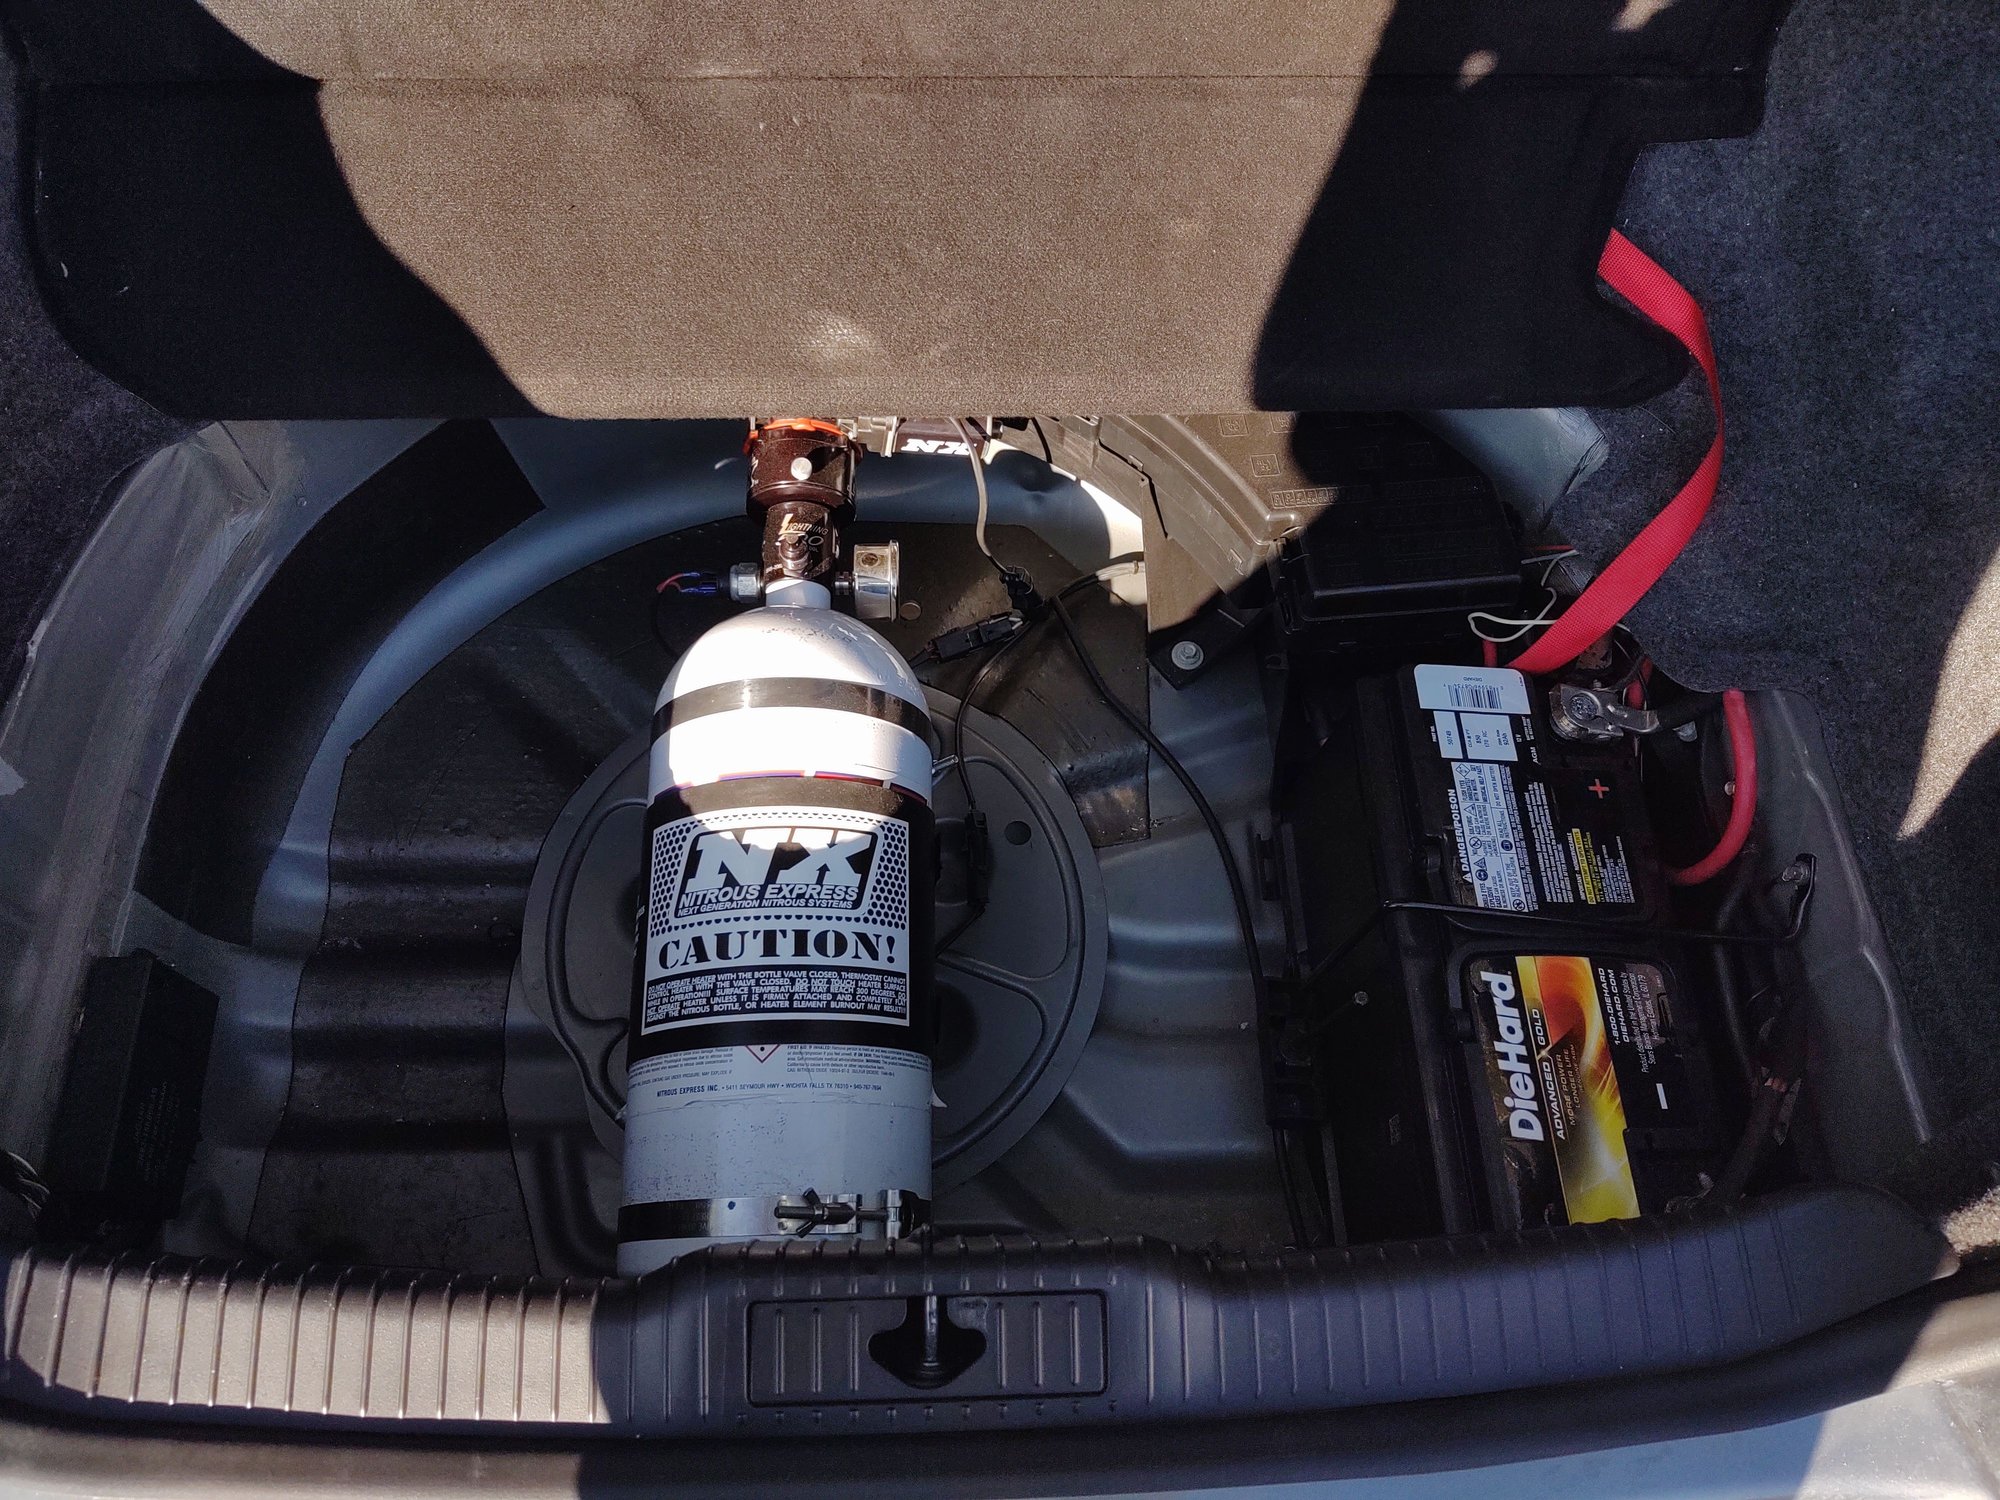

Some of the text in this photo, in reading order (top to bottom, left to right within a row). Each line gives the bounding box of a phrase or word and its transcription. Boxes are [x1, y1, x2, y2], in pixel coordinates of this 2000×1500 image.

[901, 439, 977, 455] NX
[778, 513, 829, 536] LIGHTNING
[1447, 788, 1471, 873] DANGER/POISON
[686, 827, 874, 889] NX
[1582, 865, 1590, 885] ATTEMPT
[679, 883, 859, 909] NITROUS EXPRESS
[1486, 887, 1495, 907] EXPLOSIVE
[678, 898, 853, 917] NEXT GENERATION NITROUS SYSTEMS
[658, 929, 896, 969] CAUTION!
[666, 978, 691, 990] OPERATE
[692, 975, 716, 985] HEATER
[717, 973, 737, 981] WITH
[738, 971, 753, 980] THE
[783, 970, 807, 978] VALVE
[841, 972, 882, 982] THERMOSTAT
[671, 985, 693, 994] HEATER
[695, 982, 713, 991] WITH
[733, 979, 756, 987] VALVE
[760, 978, 792, 986] CLOSED.
[795, 978, 808, 986] DO
[830, 979, 856, 988] TOUCH
[858, 981, 882, 989] HEATER
[883, 983, 906, 992] SURFACE
[1621, 979, 1629, 993] States
[1638, 975, 1648, 992] 60179
[716, 987, 748, 996] SURFACE
[751, 985, 808, 993] TEMPERATURES
[810, 985, 828, 993] MAY
[830, 985, 854, 993] REACH
[870, 989, 896, 998] DEGREES.
[658, 1002, 681, 1013] OPERATE
[683, 998, 707, 1008] HEATER
[710, 995, 737, 1004] UNLESS
[741, 994, 748, 1002] IT
[763, 993, 790, 1001] FIRMLY
[793, 993, 832, 1001] ATTACHED
[856, 995, 893, 1004] COMPLETELY
[681, 1005, 710, 1015] NITROUS
[713, 1003, 742, 1011] BOTTLE,
[830, 1001, 865, 1010] BURNOUT
[1608, 969, 1629, 1042] DIEHARD.COM
[1625, 994, 1633, 1010] United
[1629, 973, 1656, 1064] Sears Brands Management Corporation
[1633, 1027, 1644, 1052] distributed
[1480, 970, 1544, 1141] DieHard
[1640, 1054, 1649, 1072] Product
[1531, 1008, 1568, 1140] ADVANCED GOLD
[657, 1087, 678, 1097] NITROUS
[680, 1085, 705, 1095] EXPRESS
[707, 1084, 720, 1092] INC.
[726, 1083, 738, 1091] 5411
[1556, 1054, 1575, 1127] MORE POWER
[1568, 1070, 1580, 1109] LONGER
